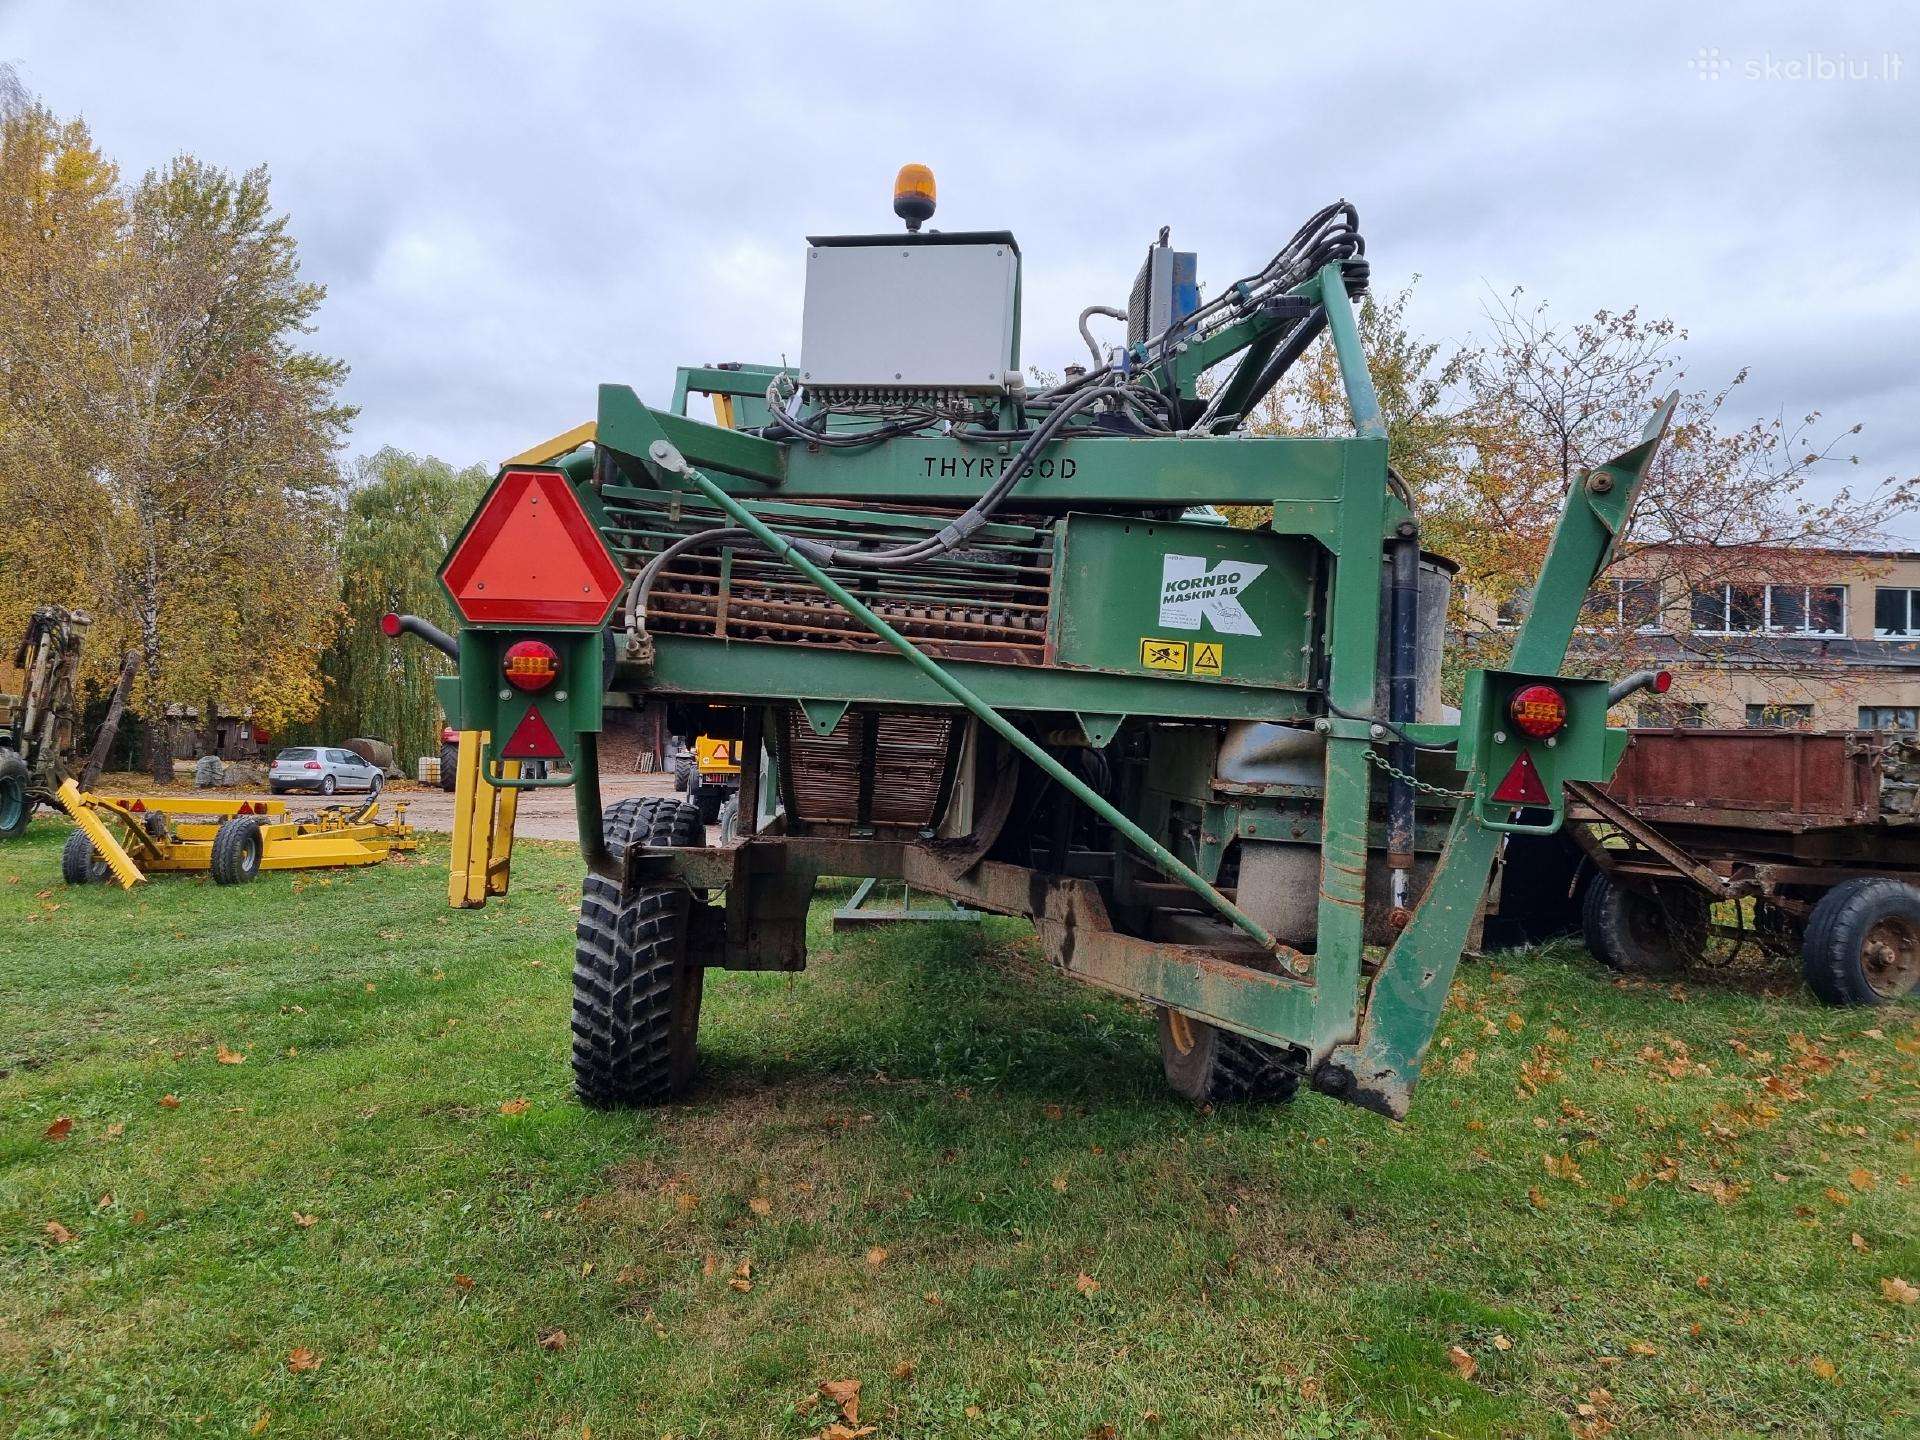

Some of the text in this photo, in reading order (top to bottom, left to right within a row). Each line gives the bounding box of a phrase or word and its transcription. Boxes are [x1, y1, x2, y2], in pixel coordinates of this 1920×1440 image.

[1165, 572, 1242, 593] KORNBO
[1162, 586, 1239, 605] MASKIN AB
